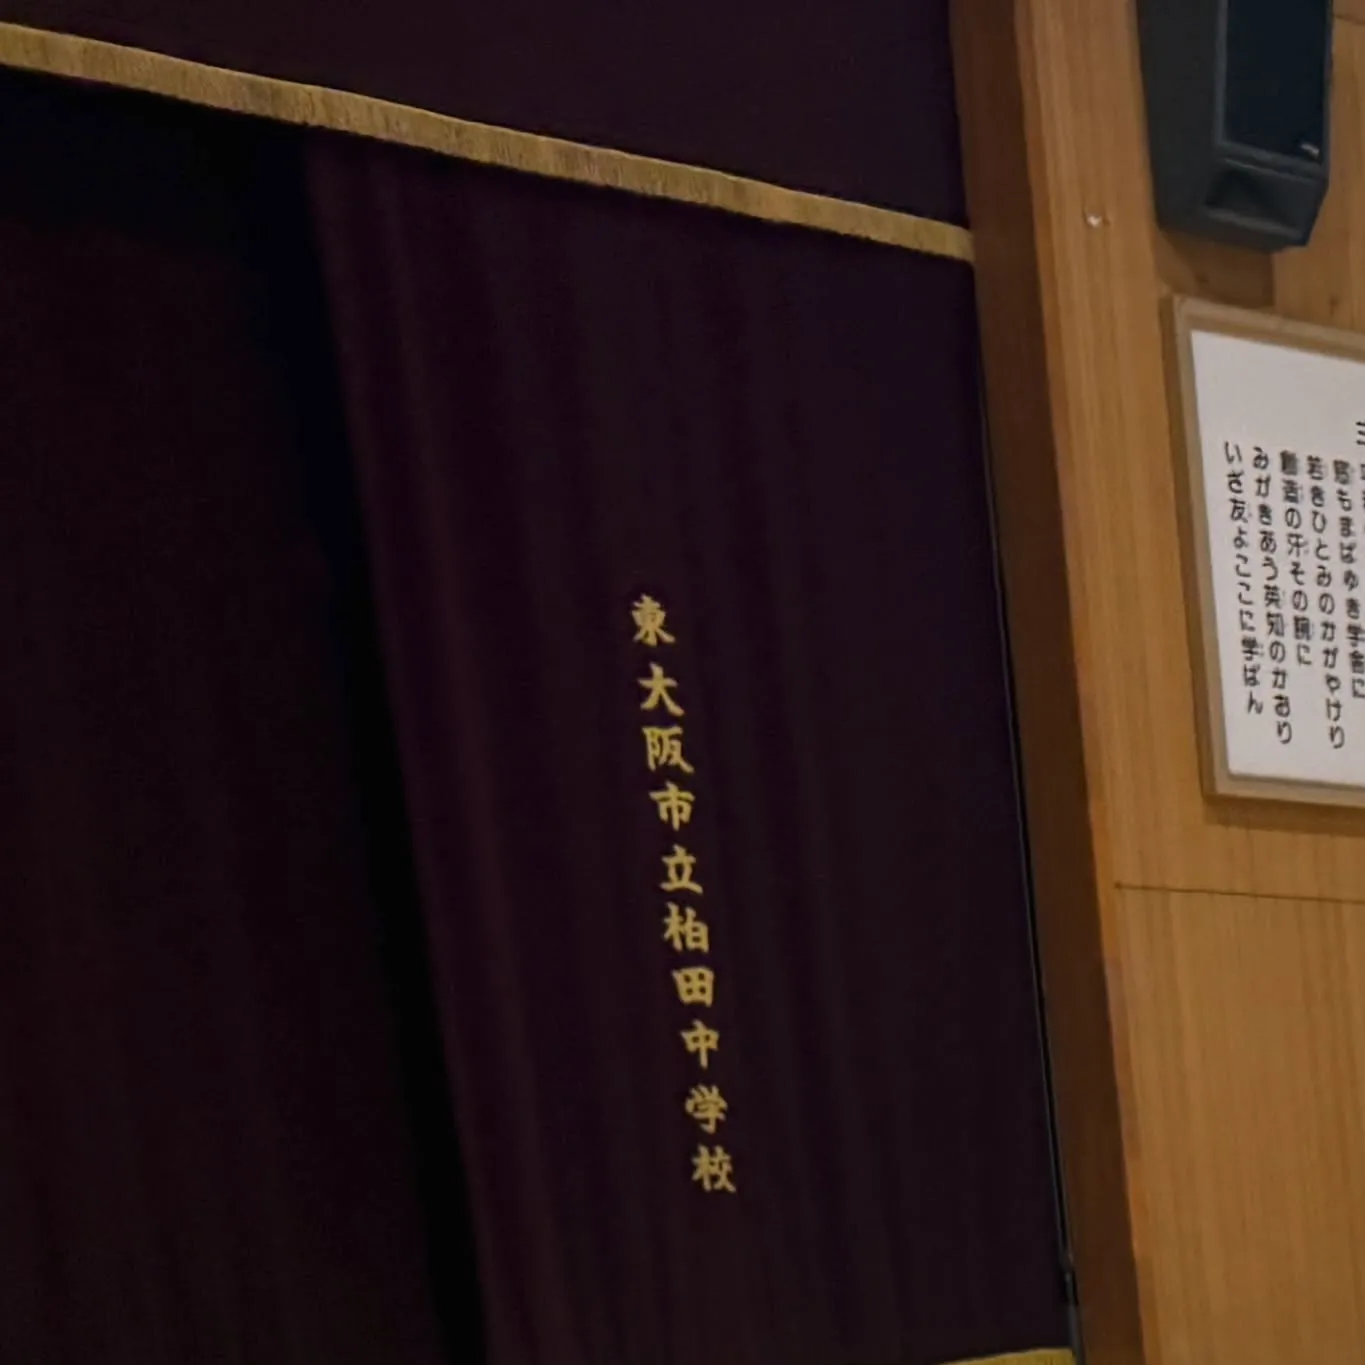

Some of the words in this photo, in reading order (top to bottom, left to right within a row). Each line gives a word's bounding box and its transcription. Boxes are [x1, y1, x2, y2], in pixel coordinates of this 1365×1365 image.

[631, 594, 736, 1192] 東大阪市立柏田中学校
